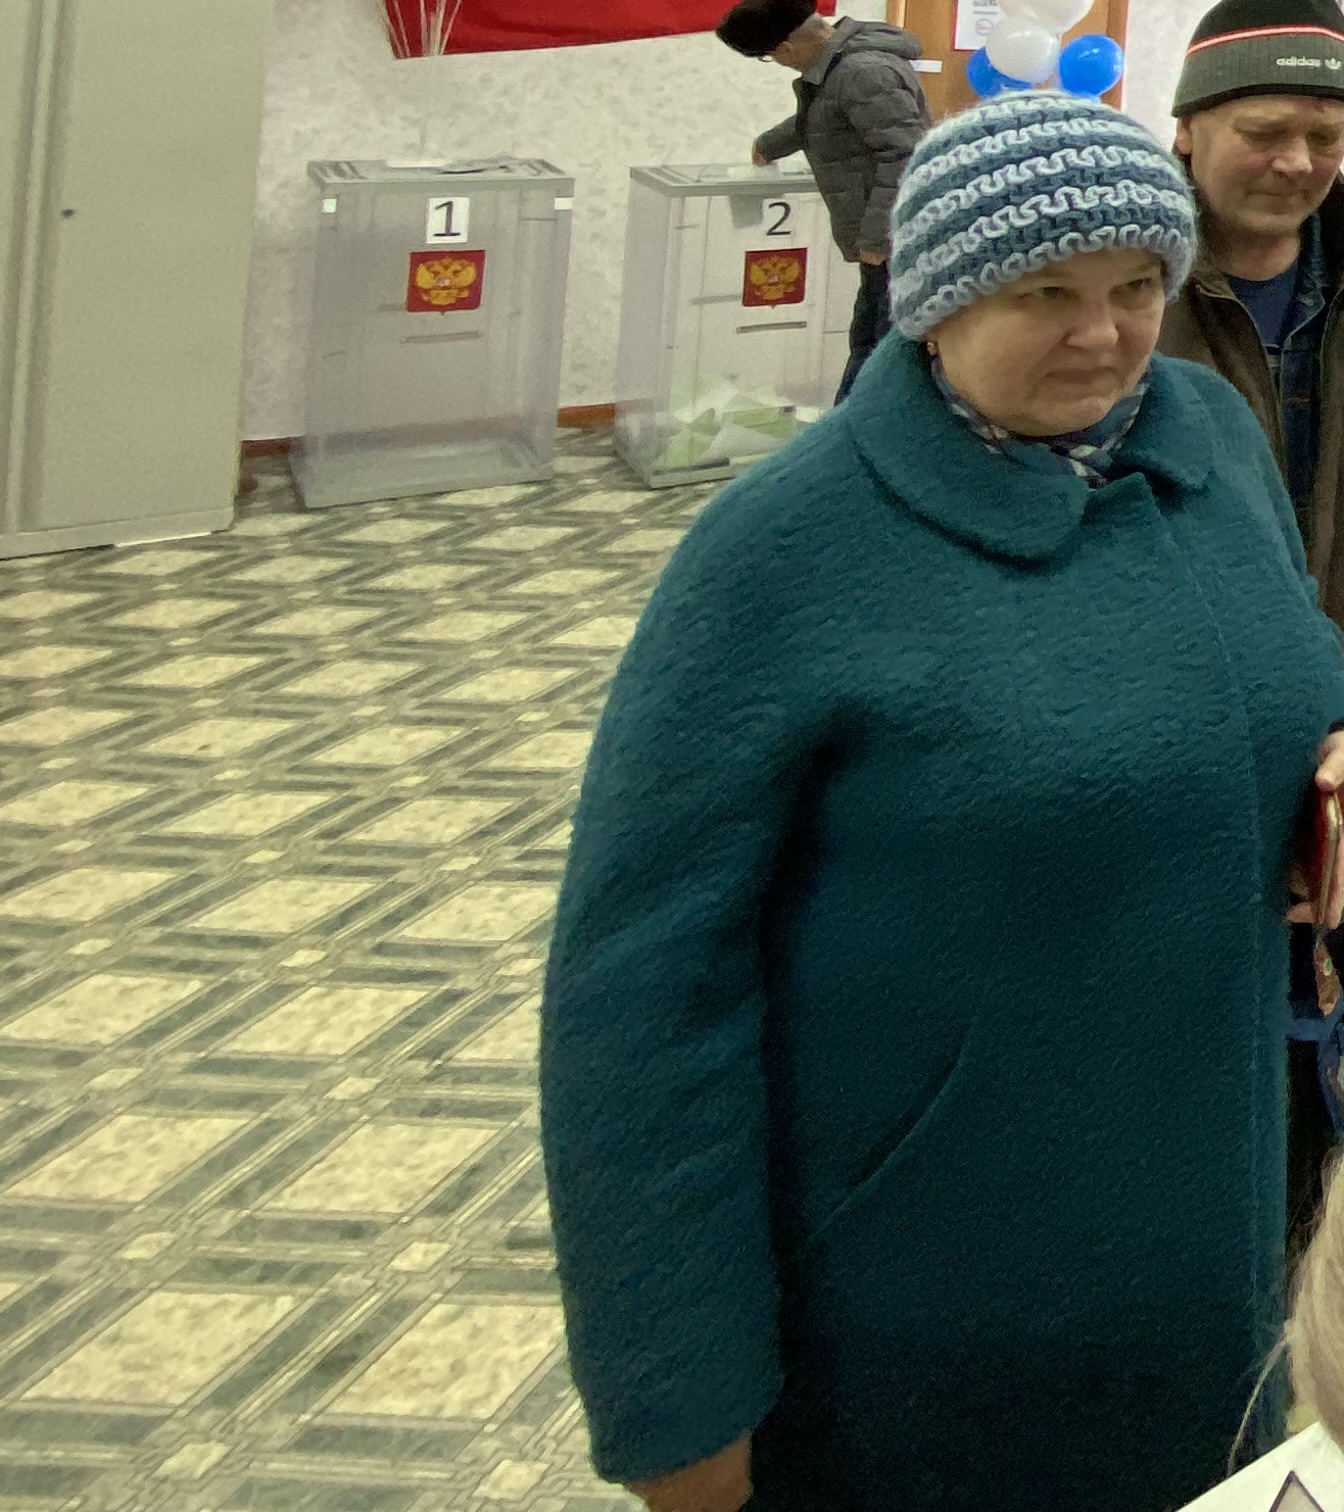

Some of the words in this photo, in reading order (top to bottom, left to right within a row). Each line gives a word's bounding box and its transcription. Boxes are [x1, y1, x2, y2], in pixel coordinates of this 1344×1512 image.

[1276, 55, 1321, 67] adidas
[433, 200, 461, 237] 1
[766, 201, 792, 236] 2
